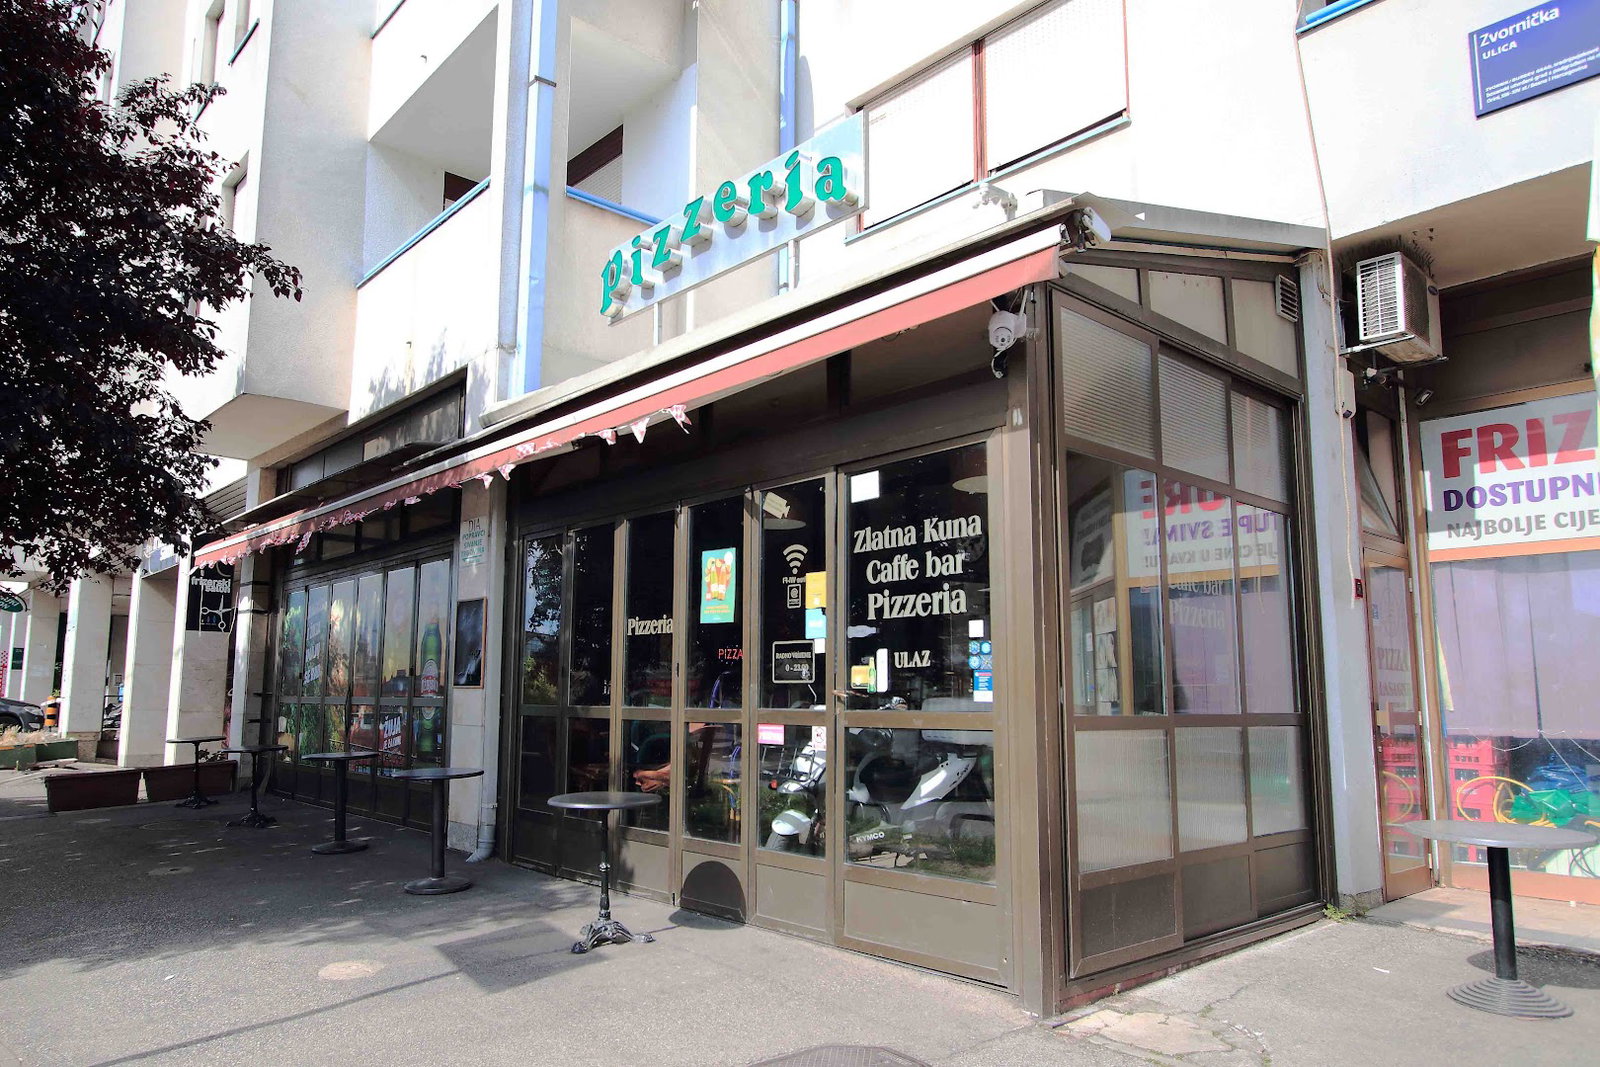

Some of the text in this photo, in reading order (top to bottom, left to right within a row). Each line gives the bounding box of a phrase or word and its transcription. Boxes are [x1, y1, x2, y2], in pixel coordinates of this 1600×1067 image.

[1479, 7, 1560, 48] Zvornička
[1481, 40, 1518, 60] ULICA
[600, 150, 847, 316] pizzeria
[1443, 473, 1600, 512] DOSTUPN
[853, 514, 983, 554] Zlatna Kuna
[1447, 508, 1600, 541] NAJBOLJE CIJE
[866, 549, 966, 585] Caffe bar
[191, 576, 231, 588] frizerski
[205, 584, 231, 594] salon
[867, 582, 968, 621] Pizzeria
[627, 614, 673, 636] Pizzeria
[718, 648, 744, 660] PIZZA
[893, 650, 931, 669] ULAZ
[855, 831, 885, 843] KYMCO
